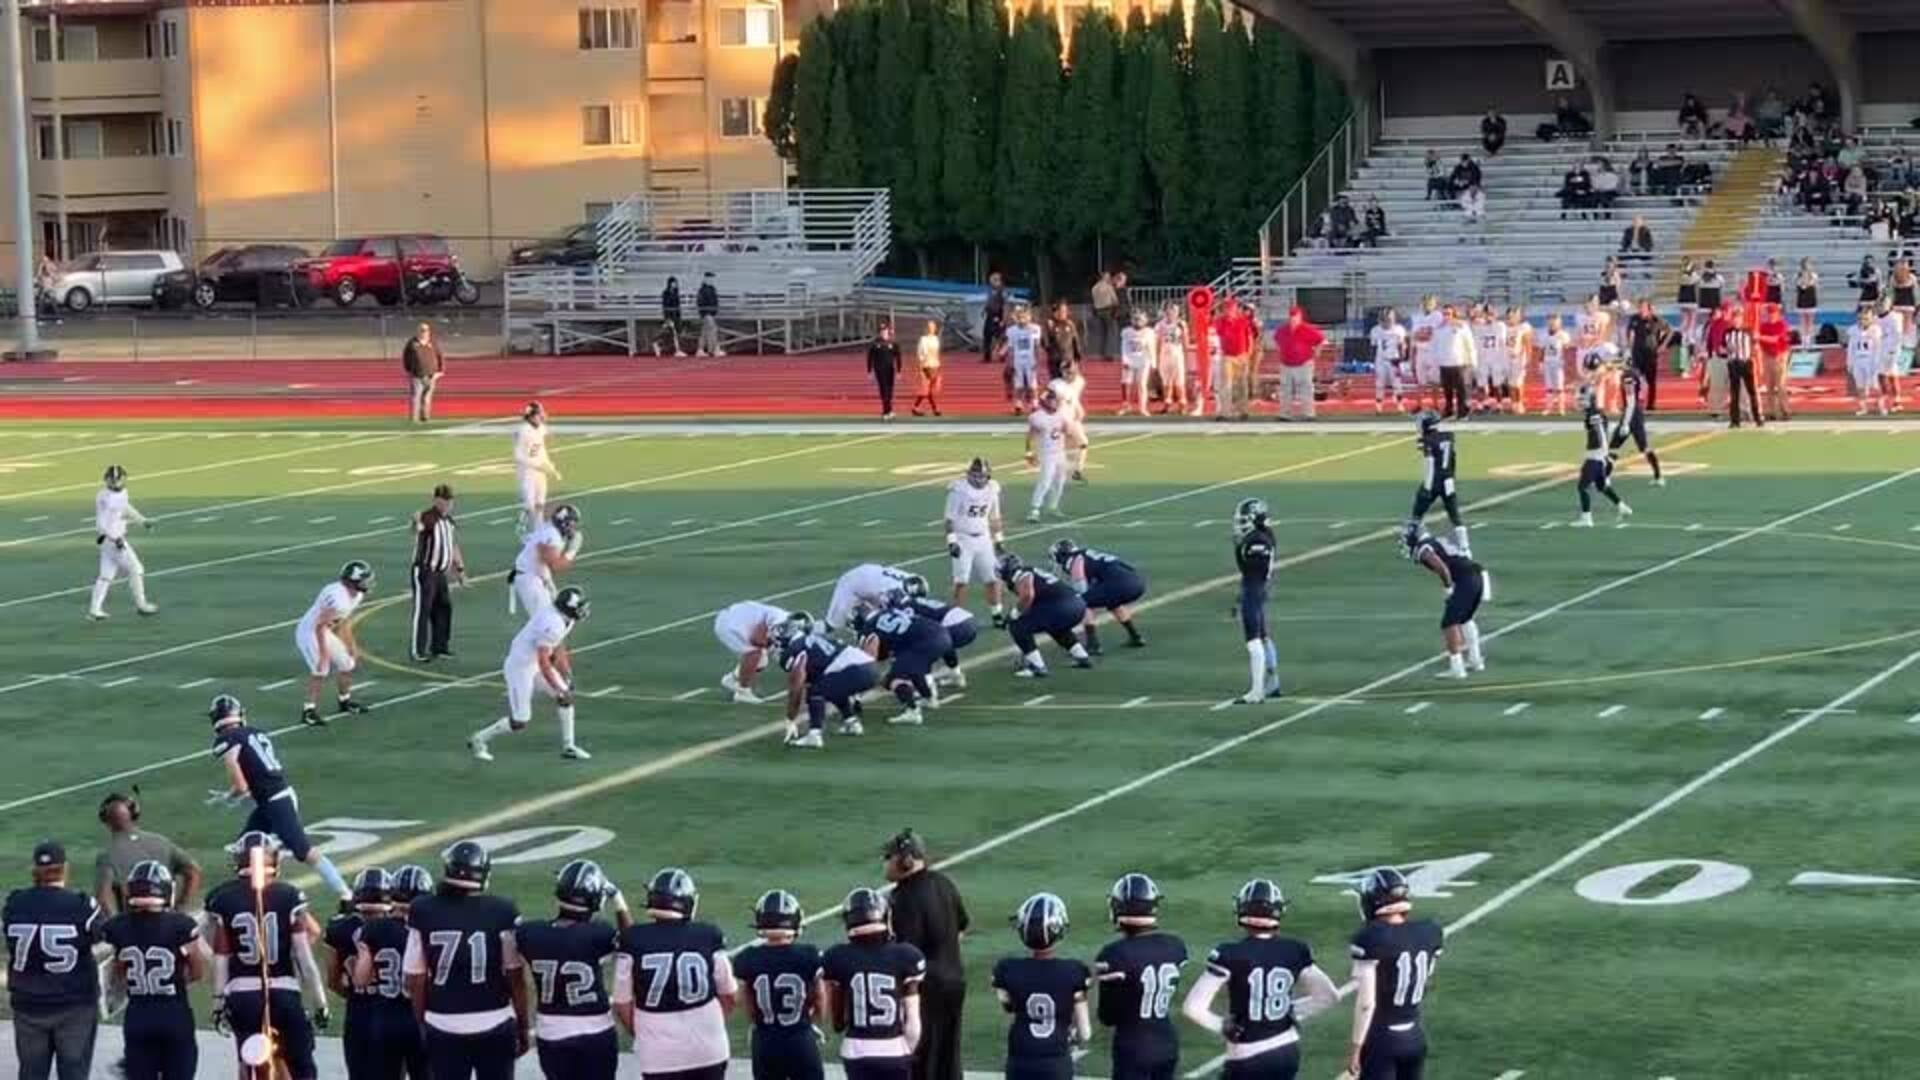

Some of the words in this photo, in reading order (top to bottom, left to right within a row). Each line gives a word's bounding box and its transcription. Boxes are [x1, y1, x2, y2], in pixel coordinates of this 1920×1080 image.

[1552, 63, 1570, 85] A
[7, 923, 78, 973] 75
[231, 911, 279, 965] 31
[429, 930, 488, 986] 71
[118, 945, 176, 996] 32
[531, 959, 597, 1006] 72
[641, 951, 708, 1007] 70
[1140, 962, 1181, 1019] 16
[1248, 966, 1295, 1021] 18
[753, 973, 806, 1026] 13
[850, 971, 898, 1028] 15
[1026, 993, 1056, 1039] 9
